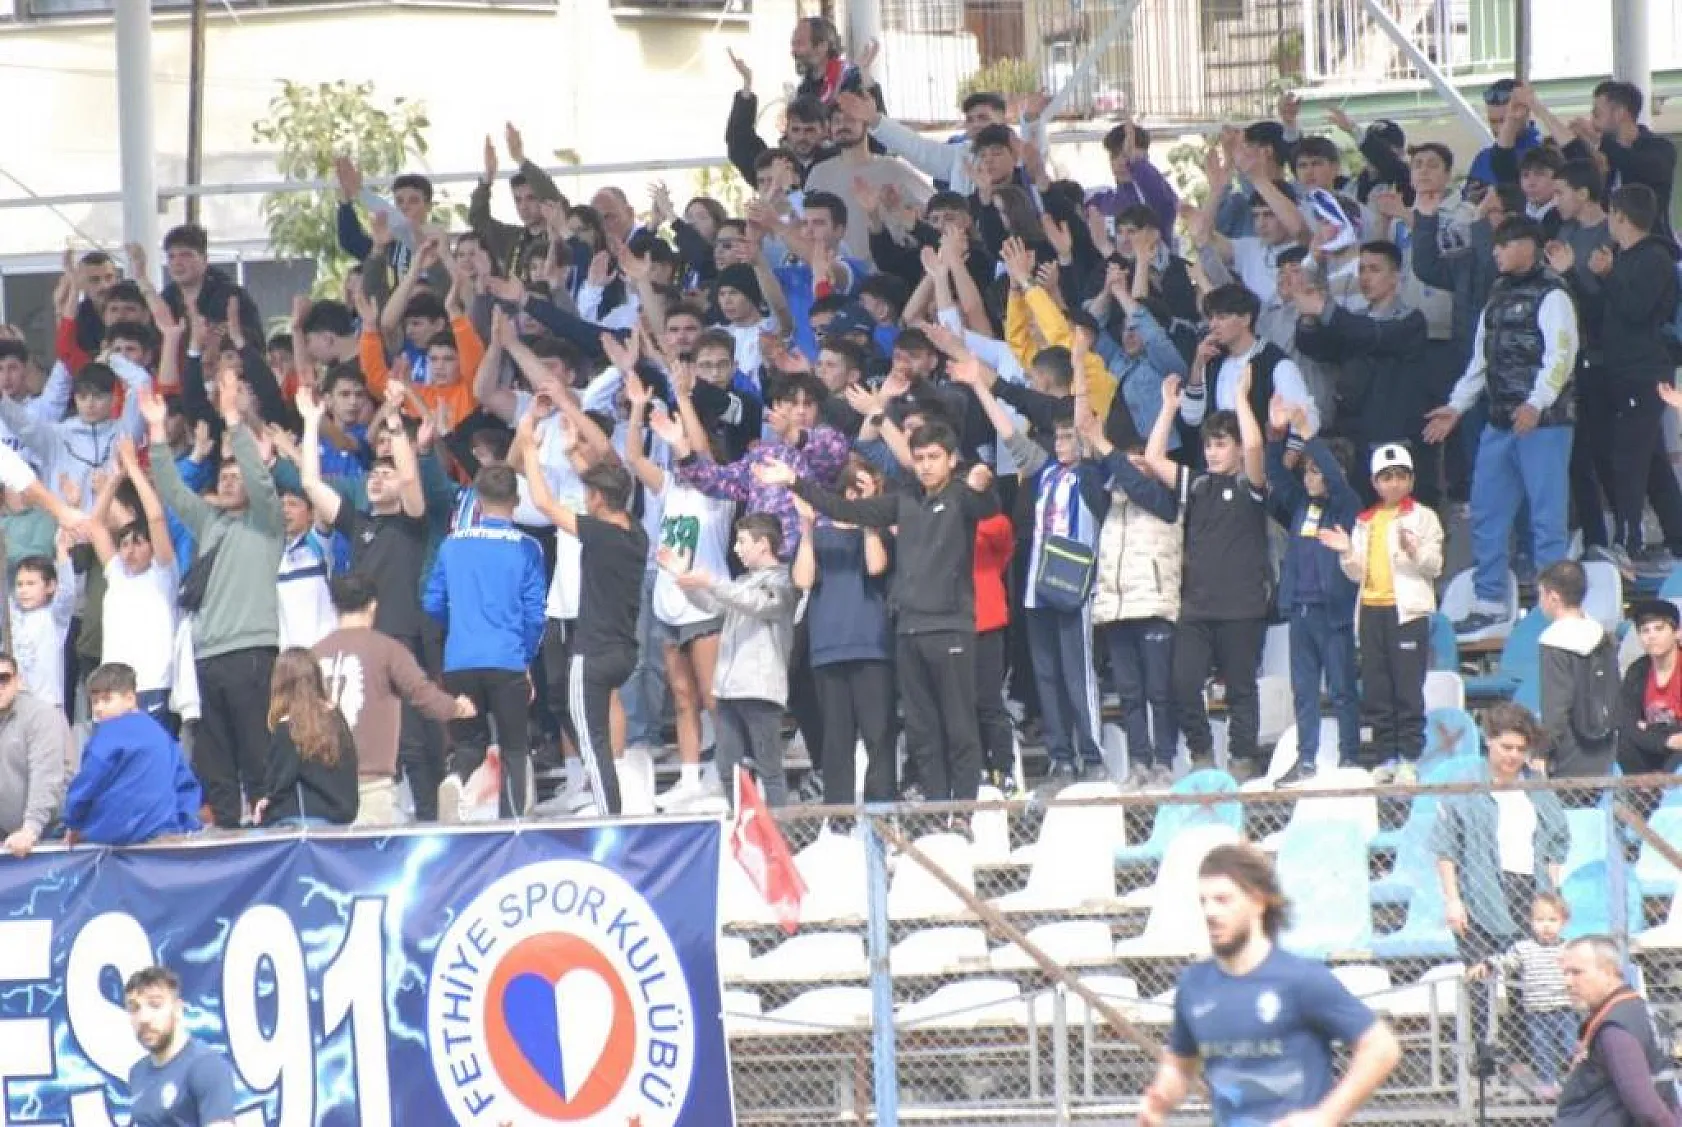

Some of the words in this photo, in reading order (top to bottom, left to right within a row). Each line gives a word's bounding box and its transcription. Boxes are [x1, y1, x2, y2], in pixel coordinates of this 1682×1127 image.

[223, 896, 391, 1127] 91
[440, 917, 497, 1117] FETHİYE
[498, 879, 606, 928] SPOR
[606, 907, 684, 1108] KULÜBÜ
